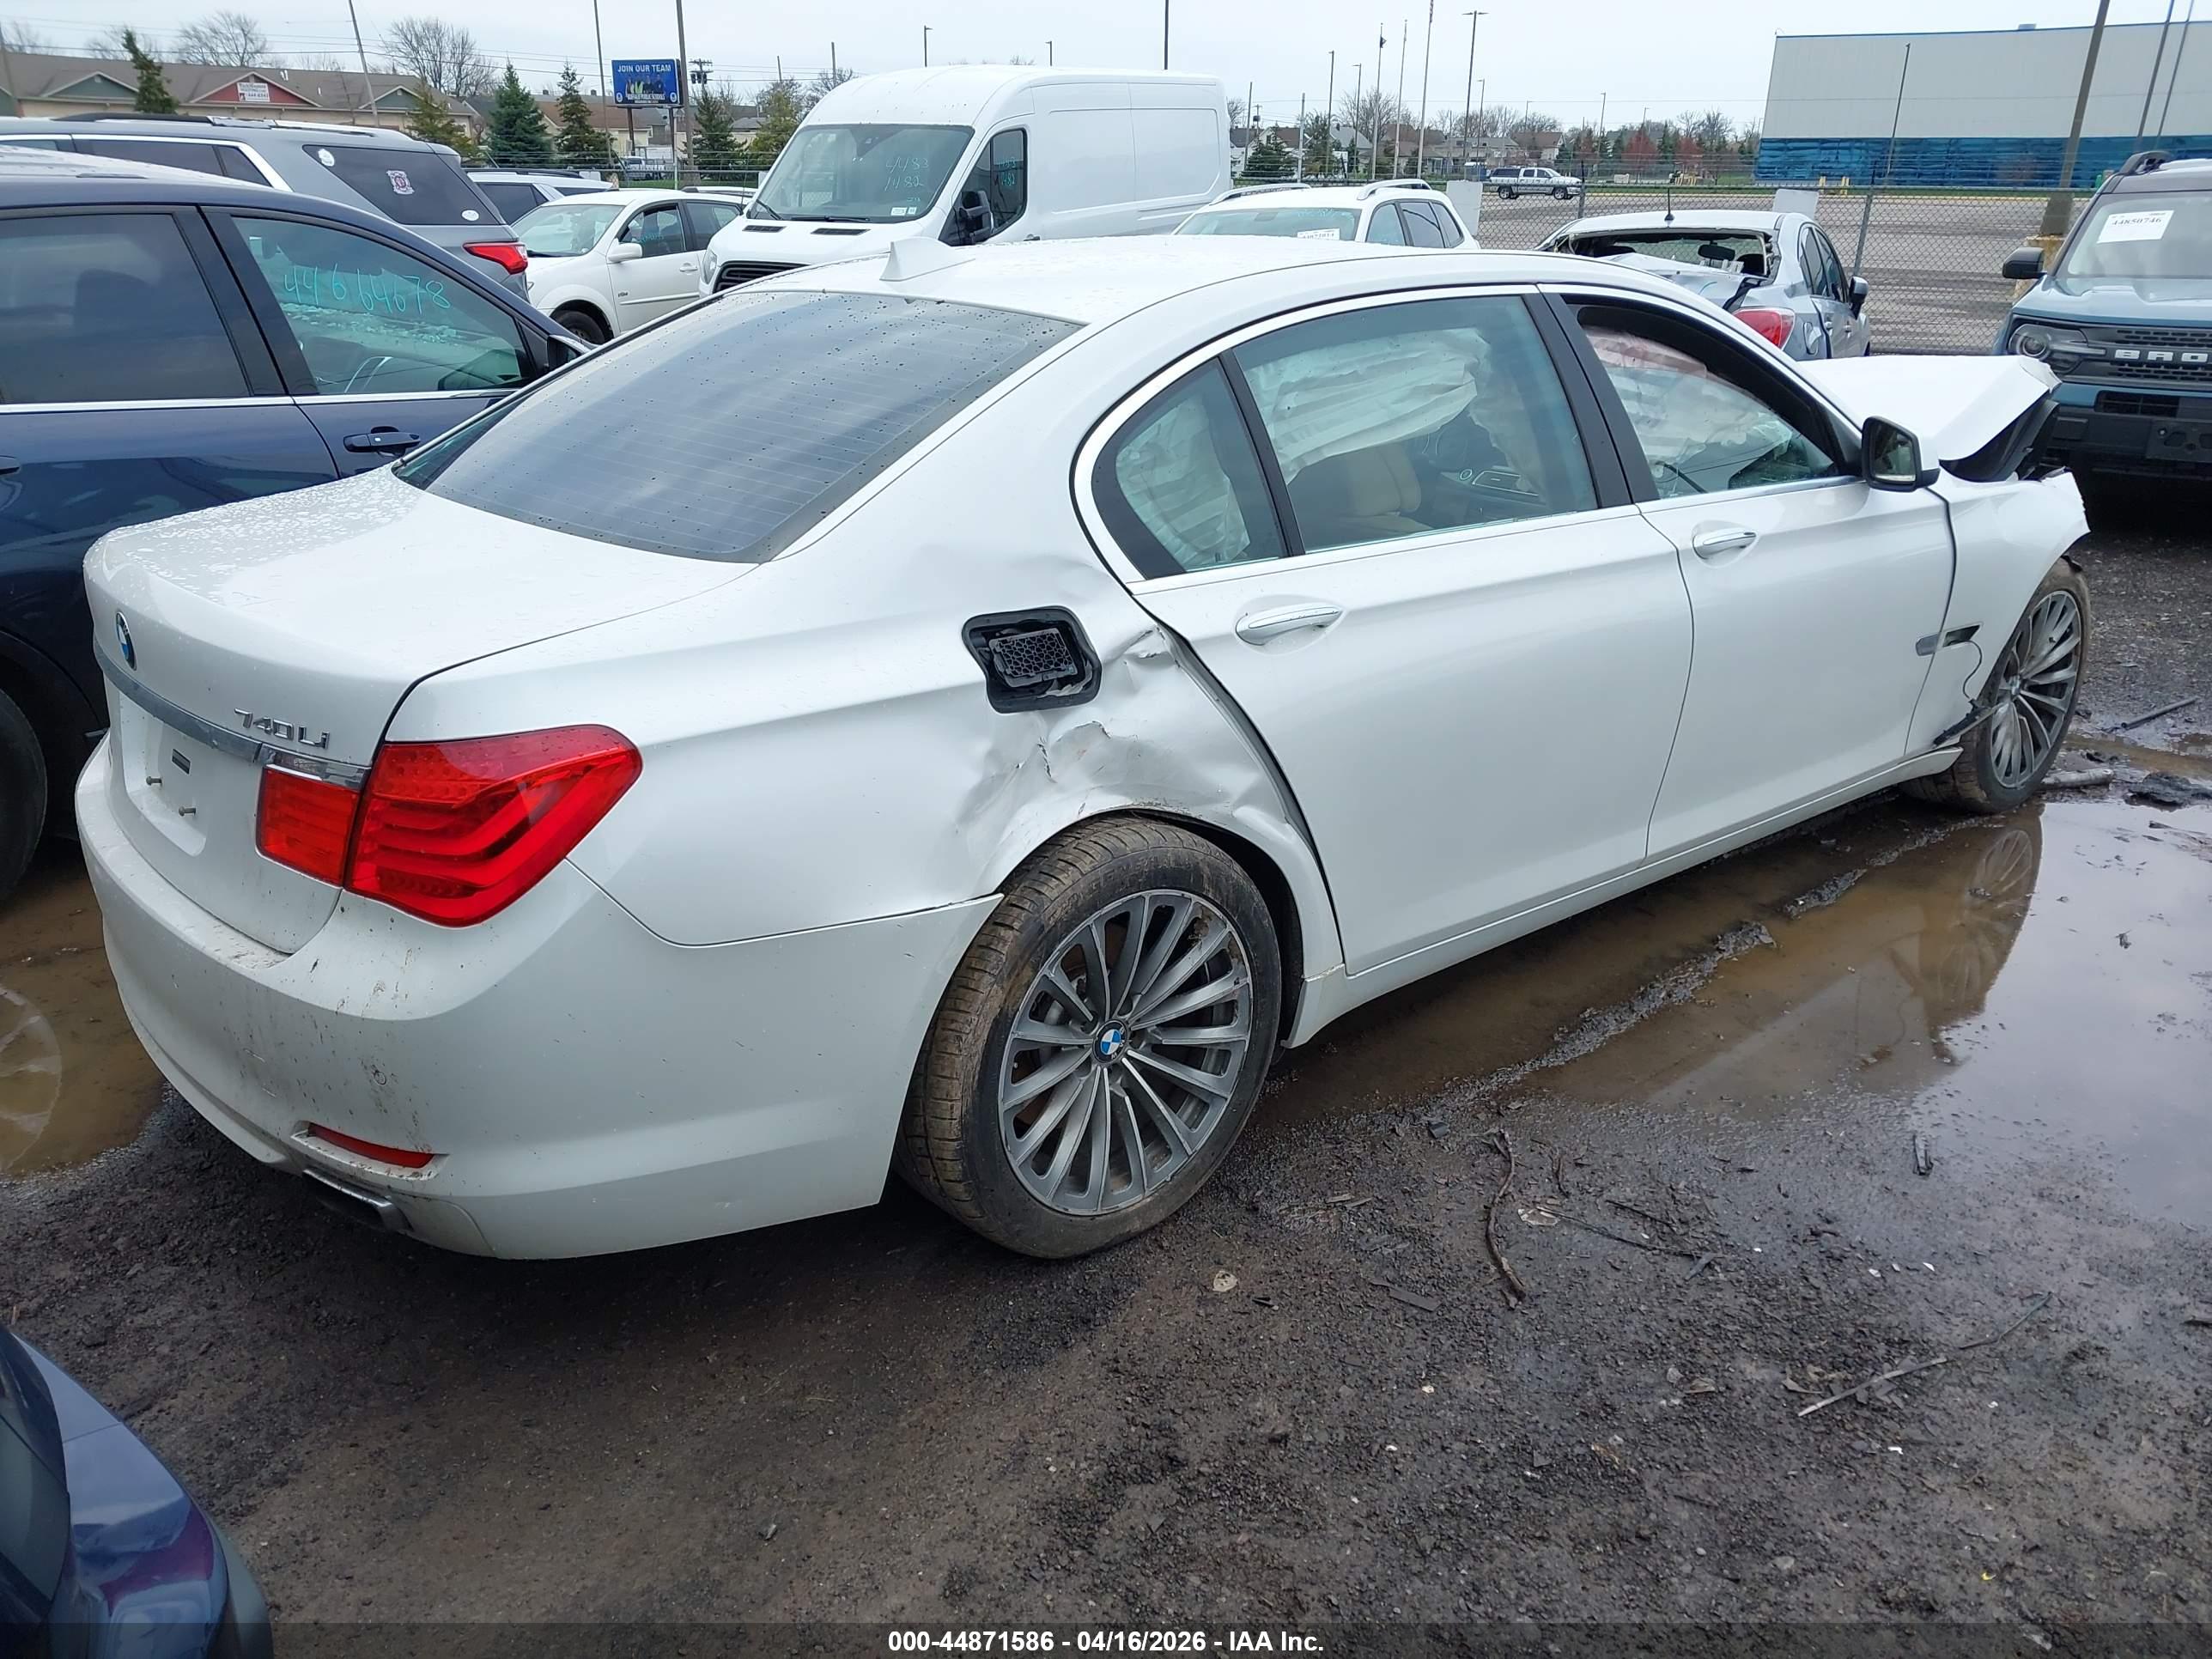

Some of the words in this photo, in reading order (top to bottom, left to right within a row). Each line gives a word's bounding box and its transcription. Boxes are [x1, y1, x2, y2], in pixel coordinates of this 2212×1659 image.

[617, 64, 634, 73] JOIN
[652, 64, 672, 72] TEAM
[2114, 349, 2212, 364] BRO
